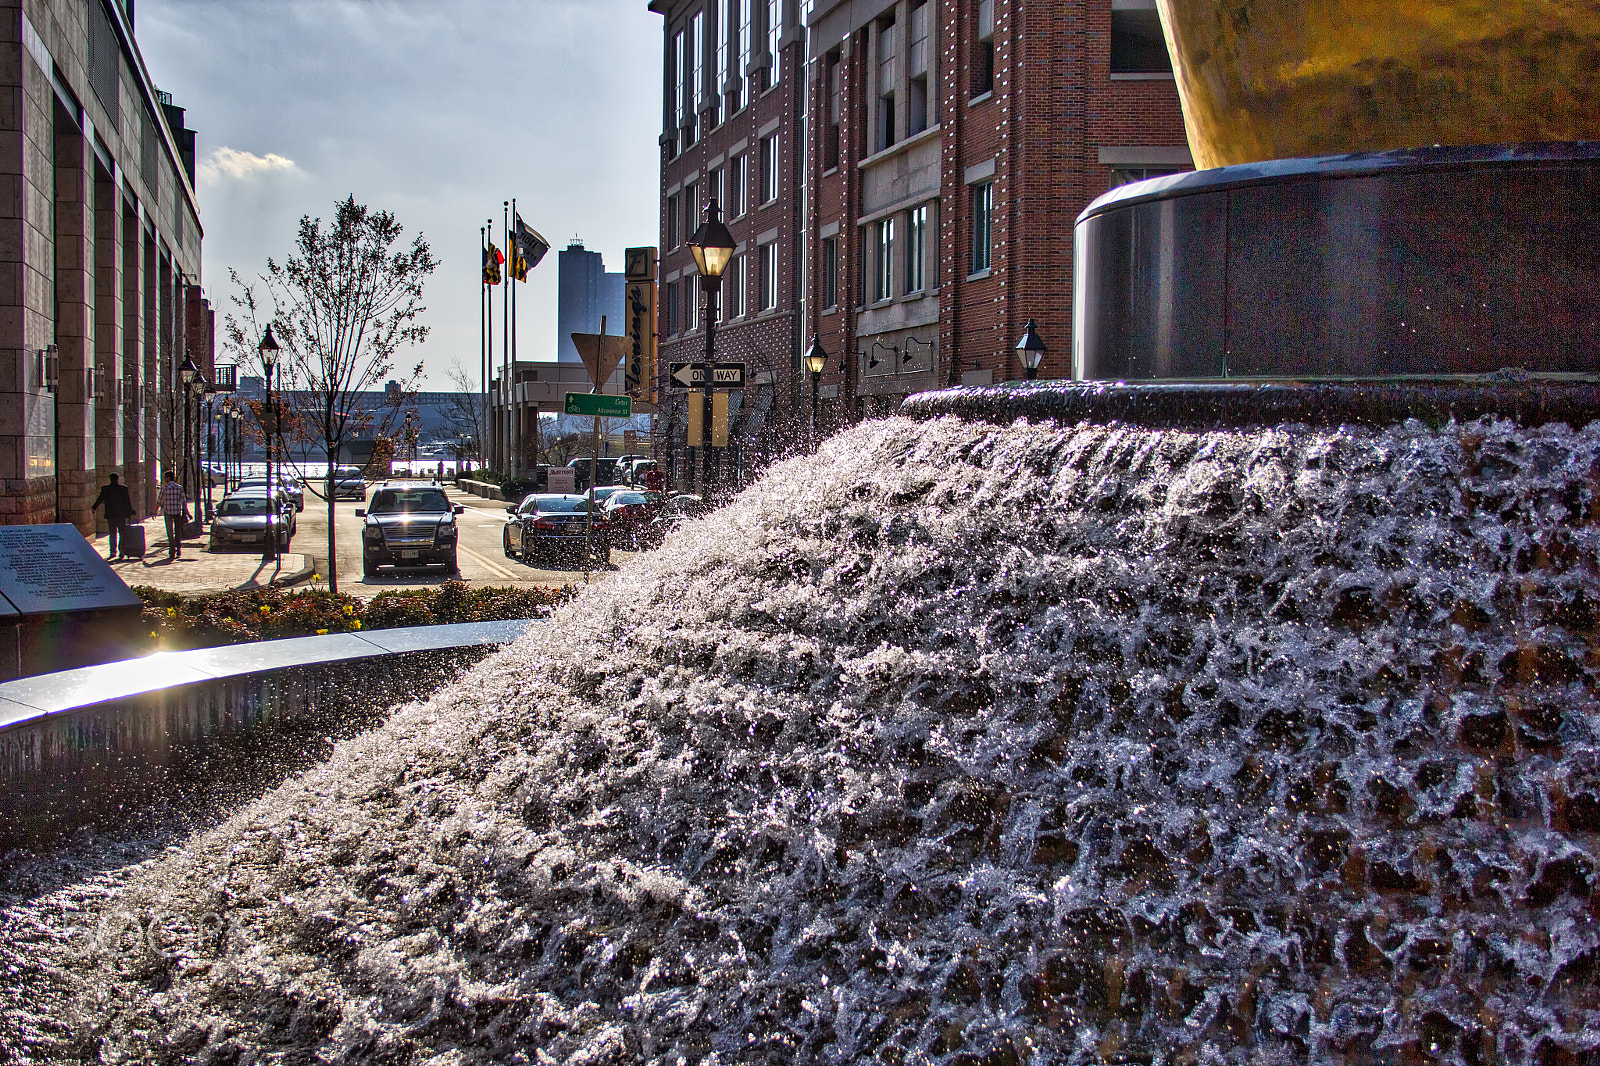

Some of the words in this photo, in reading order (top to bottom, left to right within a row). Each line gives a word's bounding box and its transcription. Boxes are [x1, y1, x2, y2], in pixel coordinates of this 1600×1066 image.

[626, 285, 648, 398] Fleming's
[692, 370, 706, 381] ON
[716, 370, 738, 381] WAY
